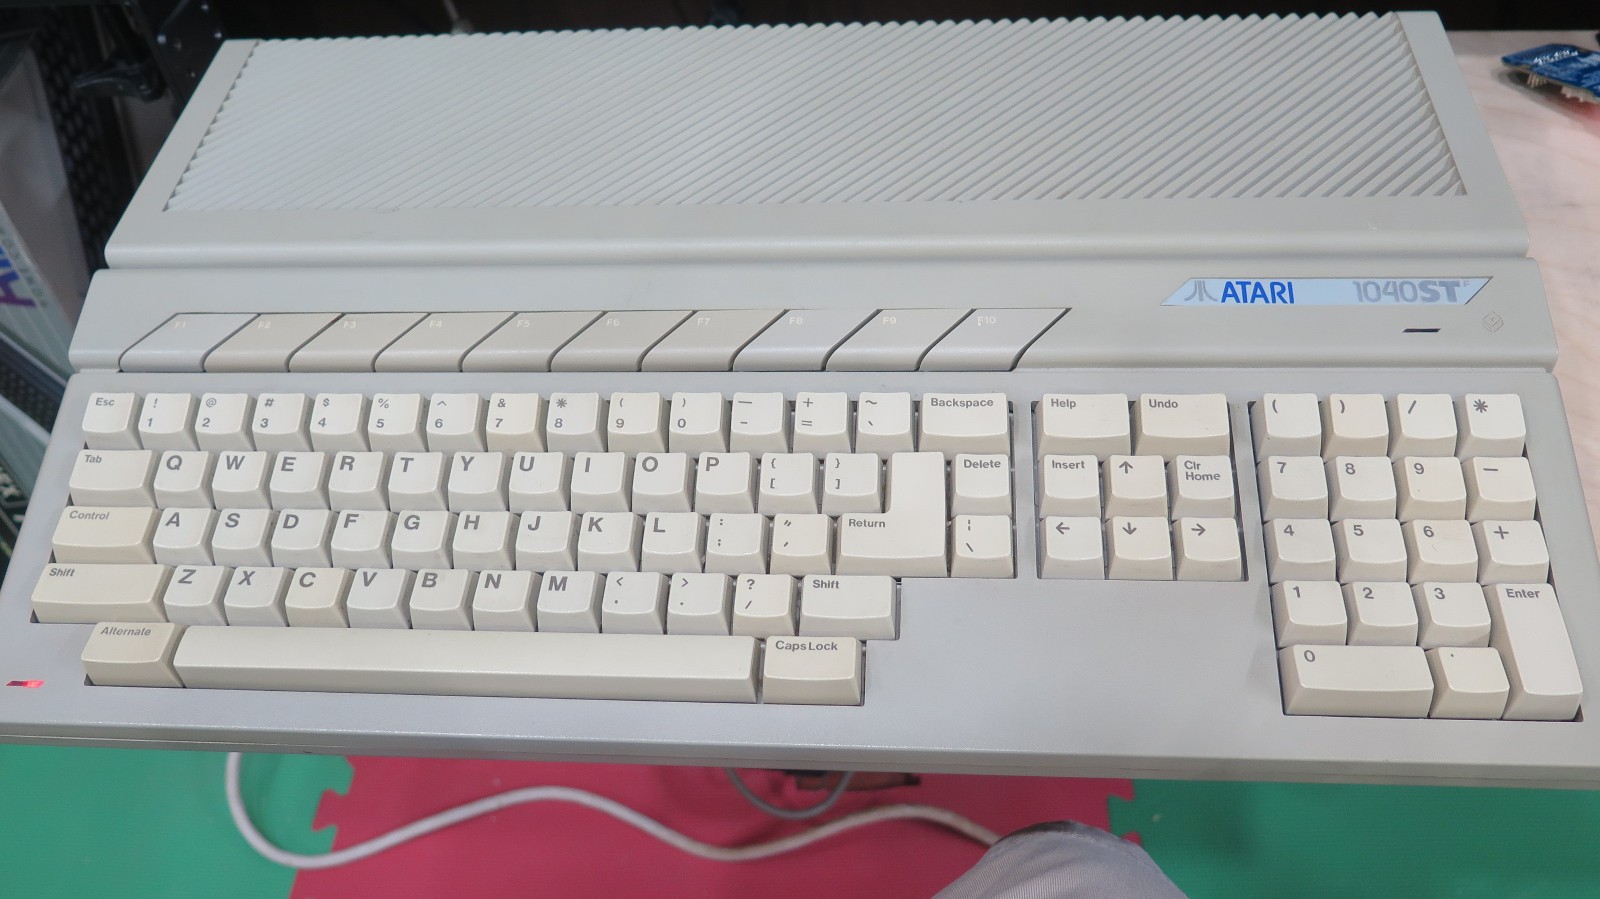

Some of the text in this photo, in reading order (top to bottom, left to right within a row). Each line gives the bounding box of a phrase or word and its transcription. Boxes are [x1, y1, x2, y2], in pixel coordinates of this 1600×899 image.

[1220, 279, 1296, 305] ATARI
[174, 320, 187, 329] F1
[257, 320, 272, 330] F2
[342, 320, 357, 329] F3
[428, 319, 443, 329] F4
[516, 318, 531, 328] F5
[605, 318, 620, 327] F6
[696, 316, 711, 326] F7
[788, 316, 804, 326] F8
[881, 315, 897, 325] F9
[976, 315, 997, 327] F10
[95, 397, 115, 407] Esc
[152, 397, 159, 409] !
[205, 397, 218, 409] @
[264, 397, 275, 408] #
[322, 397, 330, 408] $
[377, 397, 390, 409] %
[497, 398, 506, 408] &
[680, 397, 687, 408] )
[802, 397, 814, 408] +
[929, 397, 994, 409] Backspace
[1050, 397, 1077, 410] Help
[1148, 398, 1179, 409] Undo
[1271, 399, 1279, 414] (
[1339, 399, 1346, 414] )
[1407, 399, 1417, 415] /
[201, 417, 211, 428] 2
[259, 417, 269, 429] 3
[317, 417, 327, 428] 4
[375, 418, 385, 429] 5
[434, 418, 444, 429] 6
[495, 417, 504, 428] 7
[554, 417, 564, 429] 8
[615, 418, 625, 429] 9
[677, 418, 687, 429] 0
[84, 454, 103, 464] Tab
[165, 454, 183, 471] Q
[225, 454, 246, 471] W
[280, 456, 297, 472] E
[339, 455, 356, 471] R
[400, 456, 415, 473] T
[460, 455, 475, 472] Y
[519, 455, 536, 472] U
[584, 456, 592, 473] I
[641, 455, 659, 473] O
[705, 456, 720, 472] P
[770, 457, 777, 469] {
[834, 457, 841, 469] }
[963, 458, 1002, 469] Delete
[1051, 459, 1086, 470] Insert
[1183, 459, 1202, 471] Clr
[1276, 461, 1287, 474] 7
[1344, 462, 1356, 476] 8
[1413, 462, 1425, 475] 9
[1185, 471, 1221, 481] Home
[769, 477, 776, 490] [
[69, 509, 110, 521] Control
[164, 511, 180, 528] A
[224, 511, 241, 529] S
[343, 513, 360, 529] F
[282, 513, 300, 530] D
[403, 514, 421, 531] G
[463, 514, 481, 531] H
[527, 515, 542, 532] J
[587, 516, 604, 533] K
[652, 517, 666, 534] L
[848, 518, 886, 528] Return
[1283, 524, 1295, 537] 4
[1353, 524, 1365, 537] 5
[1422, 525, 1435, 538] 6
[1493, 525, 1510, 540] +
[48, 567, 76, 578] Shift
[177, 568, 197, 585] Z
[237, 570, 256, 586] X
[298, 571, 317, 588] C
[362, 571, 378, 588] V
[421, 571, 439, 589] B
[484, 573, 502, 590] N
[547, 575, 569, 592] M
[615, 576, 624, 587] <
[681, 577, 689, 588] >
[746, 578, 756, 590] ?
[812, 579, 840, 590] Shift
[1292, 585, 1301, 599] 1
[1362, 586, 1375, 600] 2
[1433, 587, 1446, 600] 3
[1505, 587, 1541, 599] Enter
[744, 600, 753, 610] /
[99, 626, 152, 636] Alternate
[1303, 649, 1316, 663] 0
